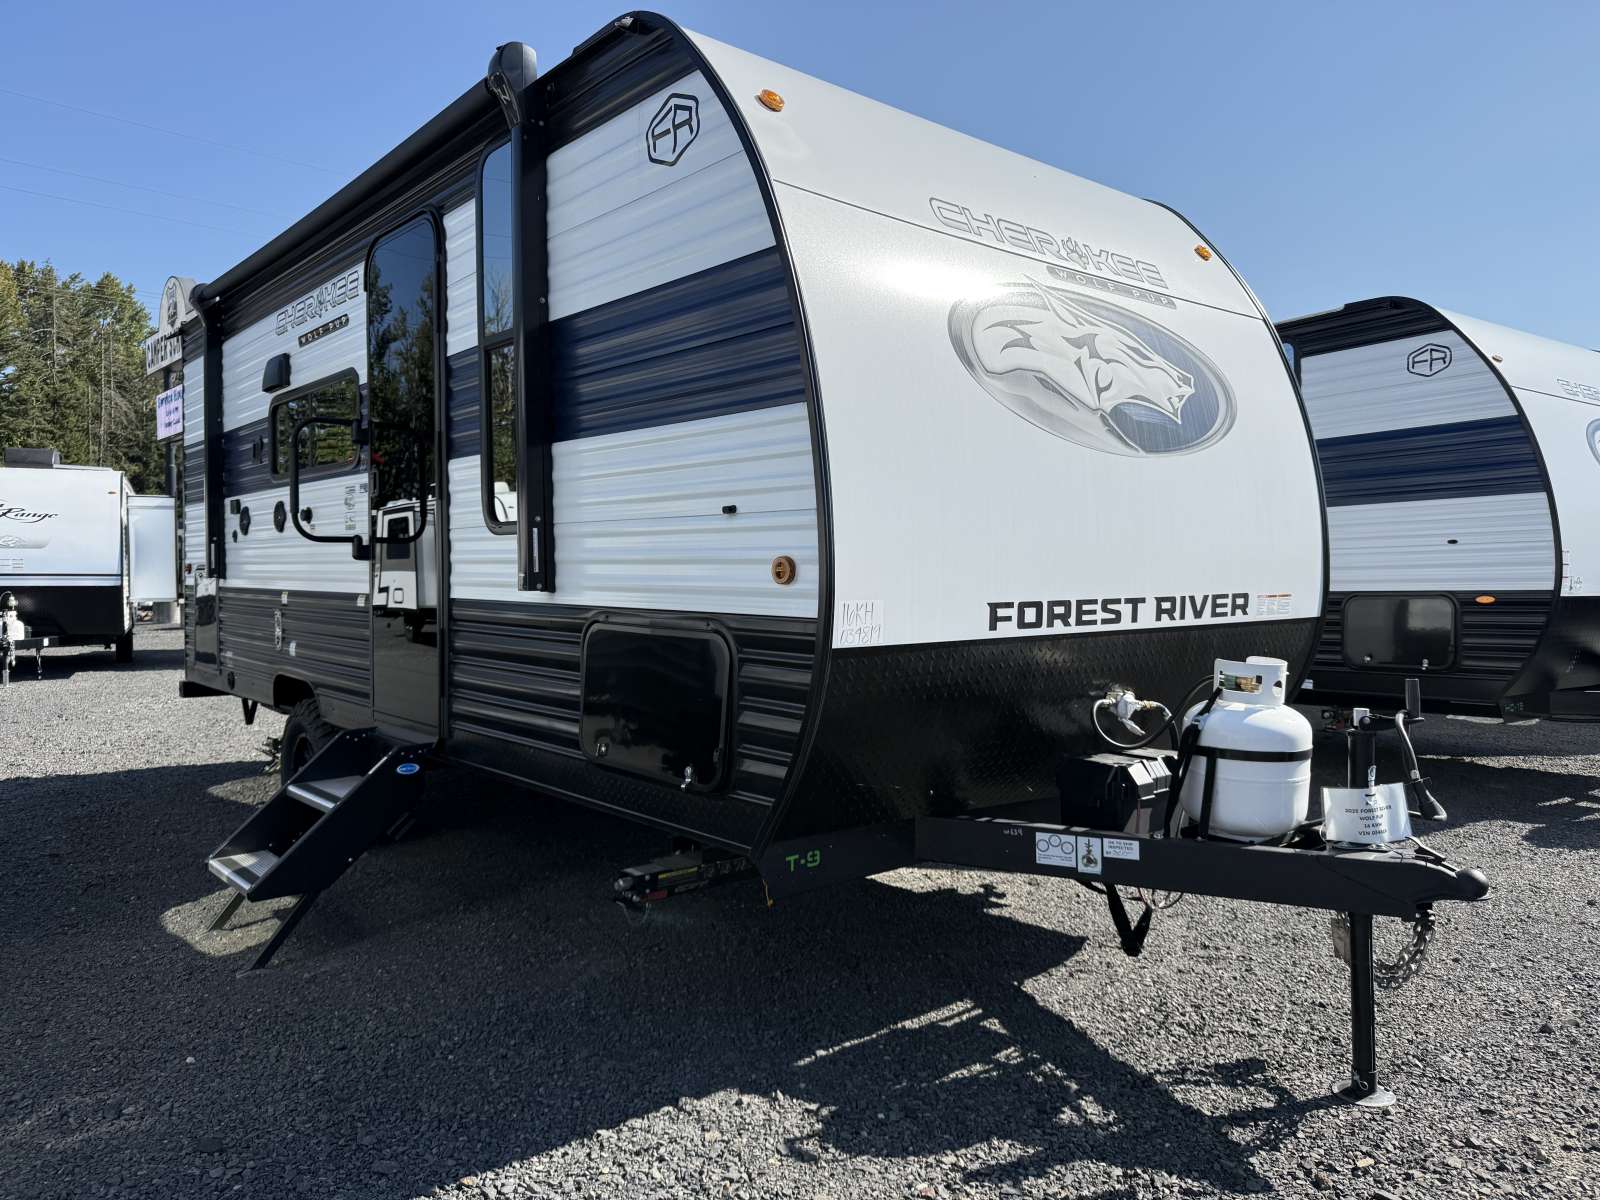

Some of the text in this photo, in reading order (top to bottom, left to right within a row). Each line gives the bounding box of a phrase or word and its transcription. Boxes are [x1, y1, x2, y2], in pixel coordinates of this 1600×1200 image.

[929, 197, 1169, 290] CHEROKEE
[1054, 268, 1170, 305] WOLF PUP
[301, 316, 347, 345] WOLF PUP
[987, 597, 1146, 632] FOREST
[1153, 592, 1249, 622] RIVER
